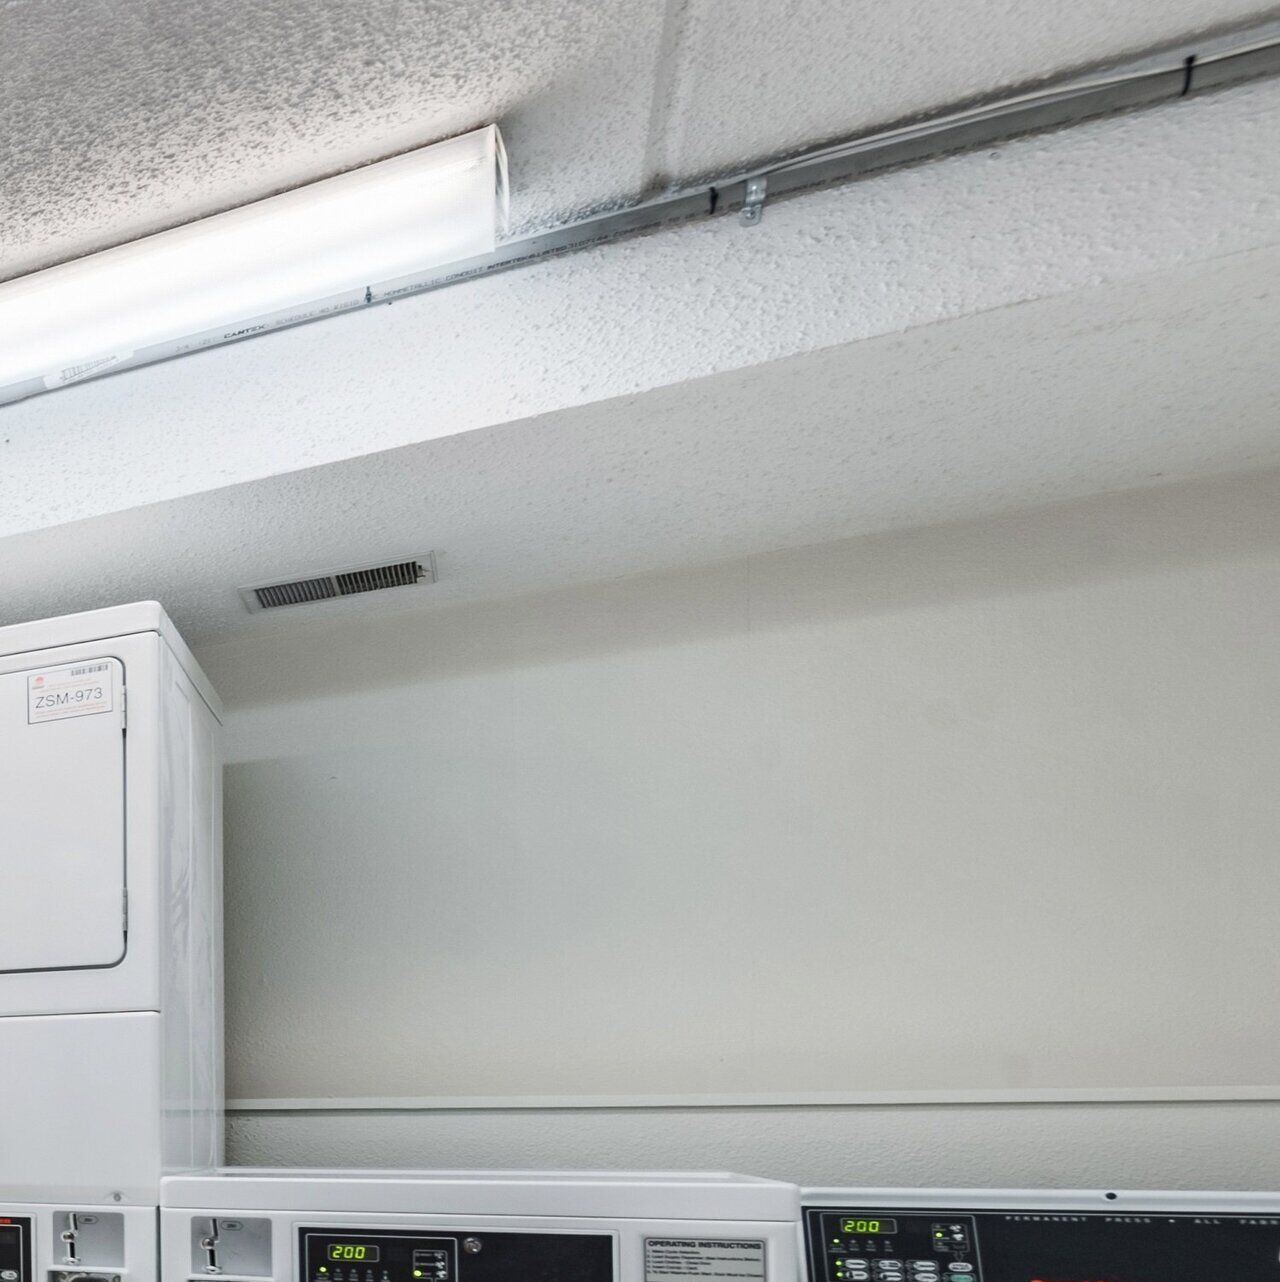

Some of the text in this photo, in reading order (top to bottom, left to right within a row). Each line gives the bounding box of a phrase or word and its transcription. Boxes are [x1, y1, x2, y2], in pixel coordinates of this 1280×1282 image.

[34, 686, 104, 709] ZSM-973
[844, 1220, 880, 1233] 200
[648, 1240, 696, 1248] OPERATING
[332, 1246, 366, 1259] 200
